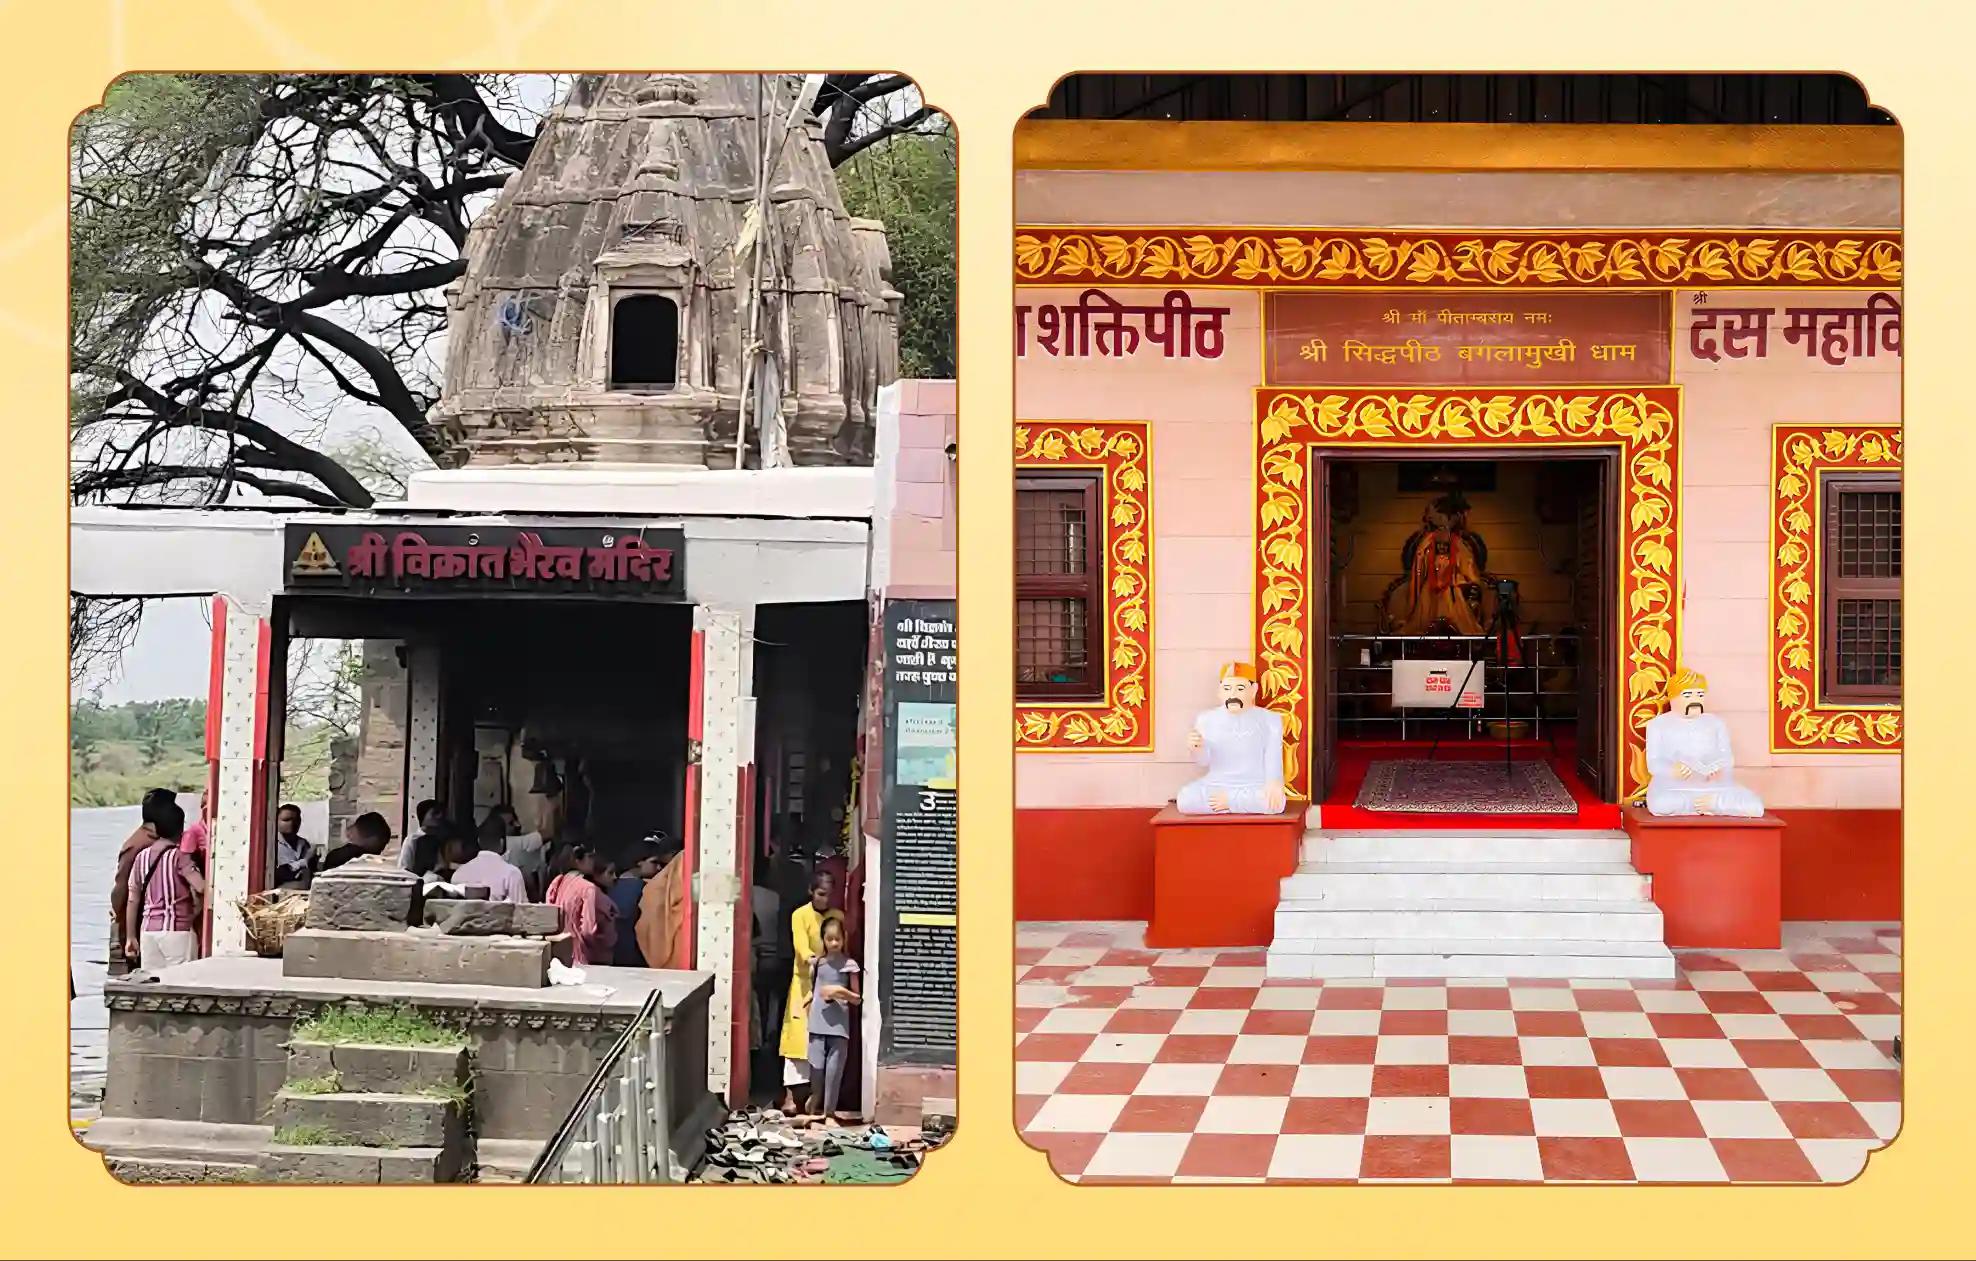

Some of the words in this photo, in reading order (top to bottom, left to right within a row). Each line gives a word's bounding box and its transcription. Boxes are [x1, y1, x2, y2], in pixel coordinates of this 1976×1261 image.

[1037, 288, 1231, 359] शक्तिपीठ
[1381, 308, 1401, 324] श्री
[1690, 308, 1776, 363] दस
[1299, 337, 1329, 363] श्री
[1342, 338, 1442, 364] सिद्धपीठ
[1456, 337, 1577, 369] बगलामुखी
[1589, 344, 1637, 361] धाम
[348, 531, 387, 577] श्री
[392, 531, 508, 579] विक्रांत
[509, 531, 583, 580] भैरव
[587, 534, 674, 582] मंदिर
